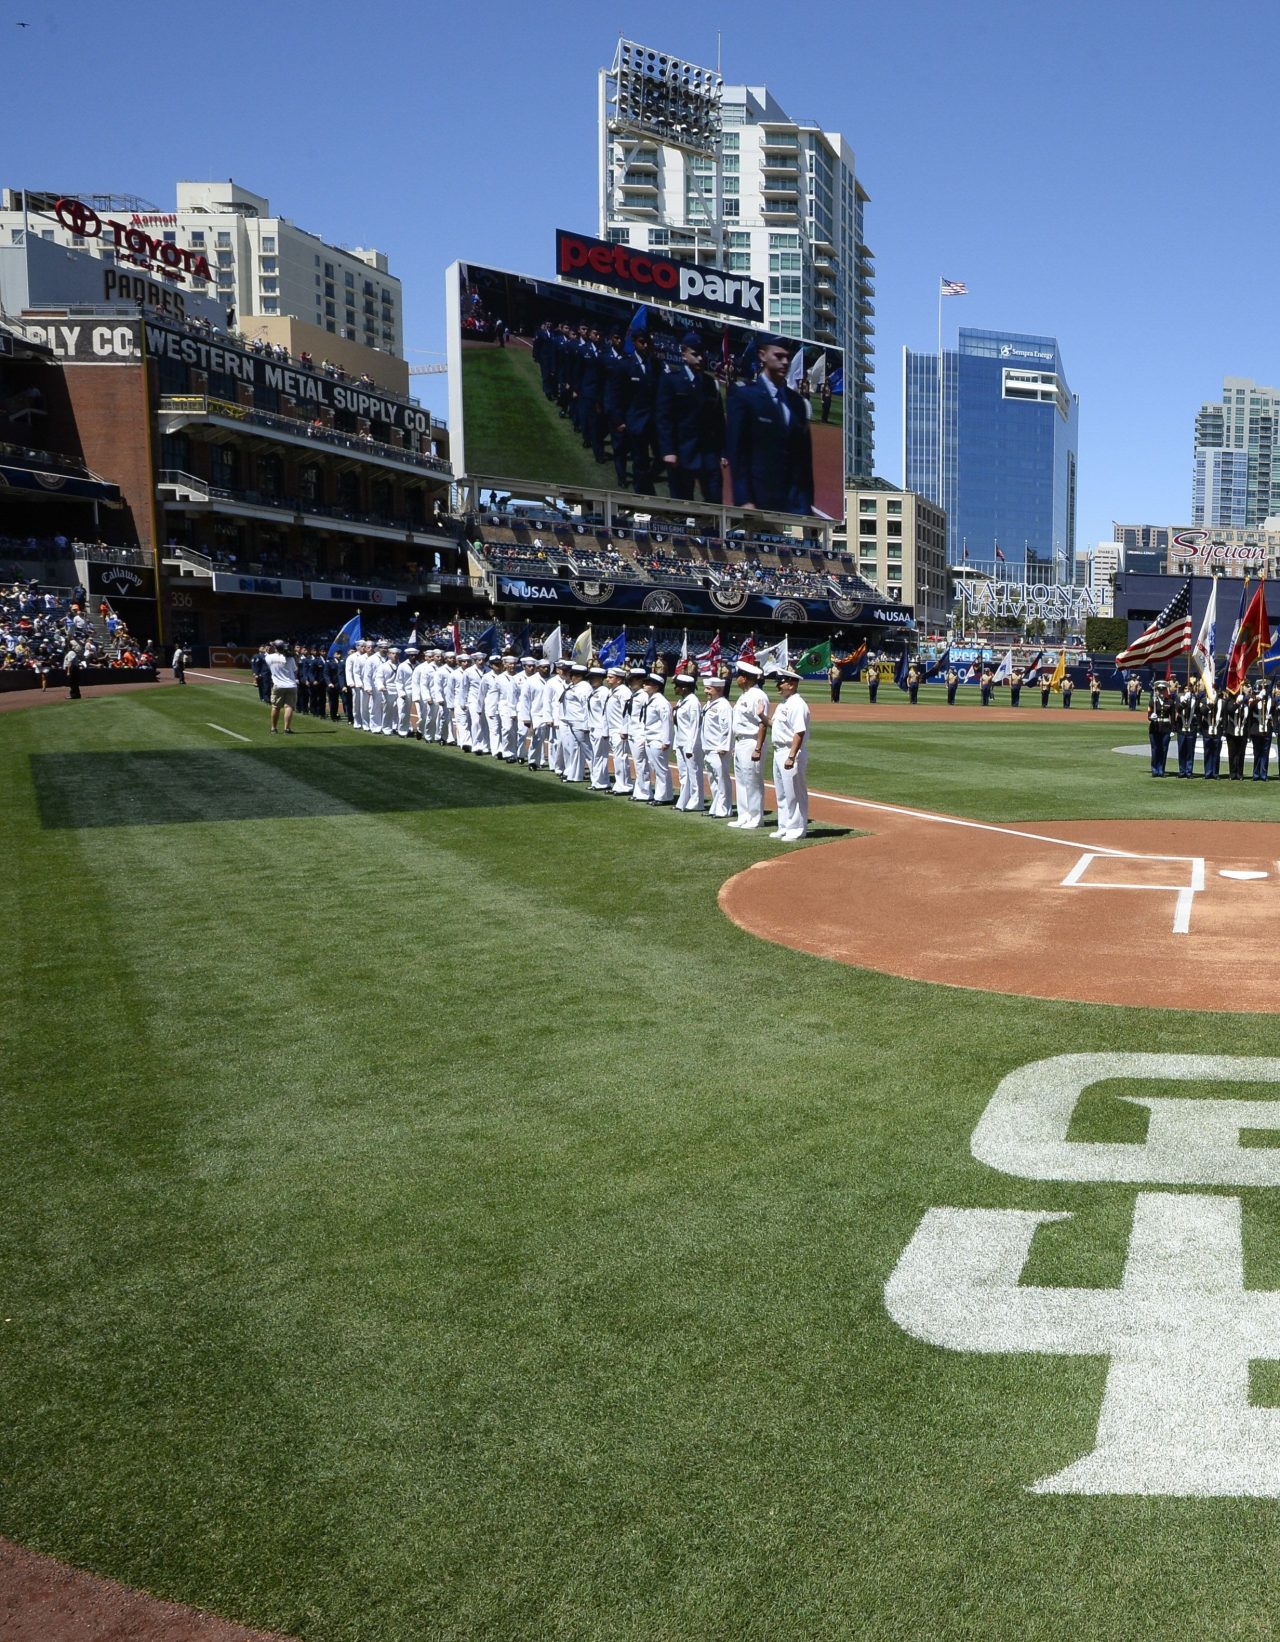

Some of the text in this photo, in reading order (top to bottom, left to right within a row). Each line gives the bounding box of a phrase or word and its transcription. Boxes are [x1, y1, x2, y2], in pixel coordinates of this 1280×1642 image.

[131, 214, 177, 225] Marriott
[108, 219, 213, 282] TOYOTA
[561, 235, 762, 312] petco park
[104, 269, 185, 320] PADRES
[92, 326, 142, 357] CO.
[1012, 348, 1054, 360] Sempra Energy
[145, 327, 430, 433] WESTERN METAL SUPPLY CO.
[1171, 530, 1269, 565] Sycuan
[101, 566, 143, 587] Callaway
[170, 591, 192, 607] 336
[521, 586, 558, 599] USAA
[954, 580, 1112, 606] NATIONAL
[886, 611, 911, 622] USAA
[967, 600, 1100, 620] UNIVERSITY
